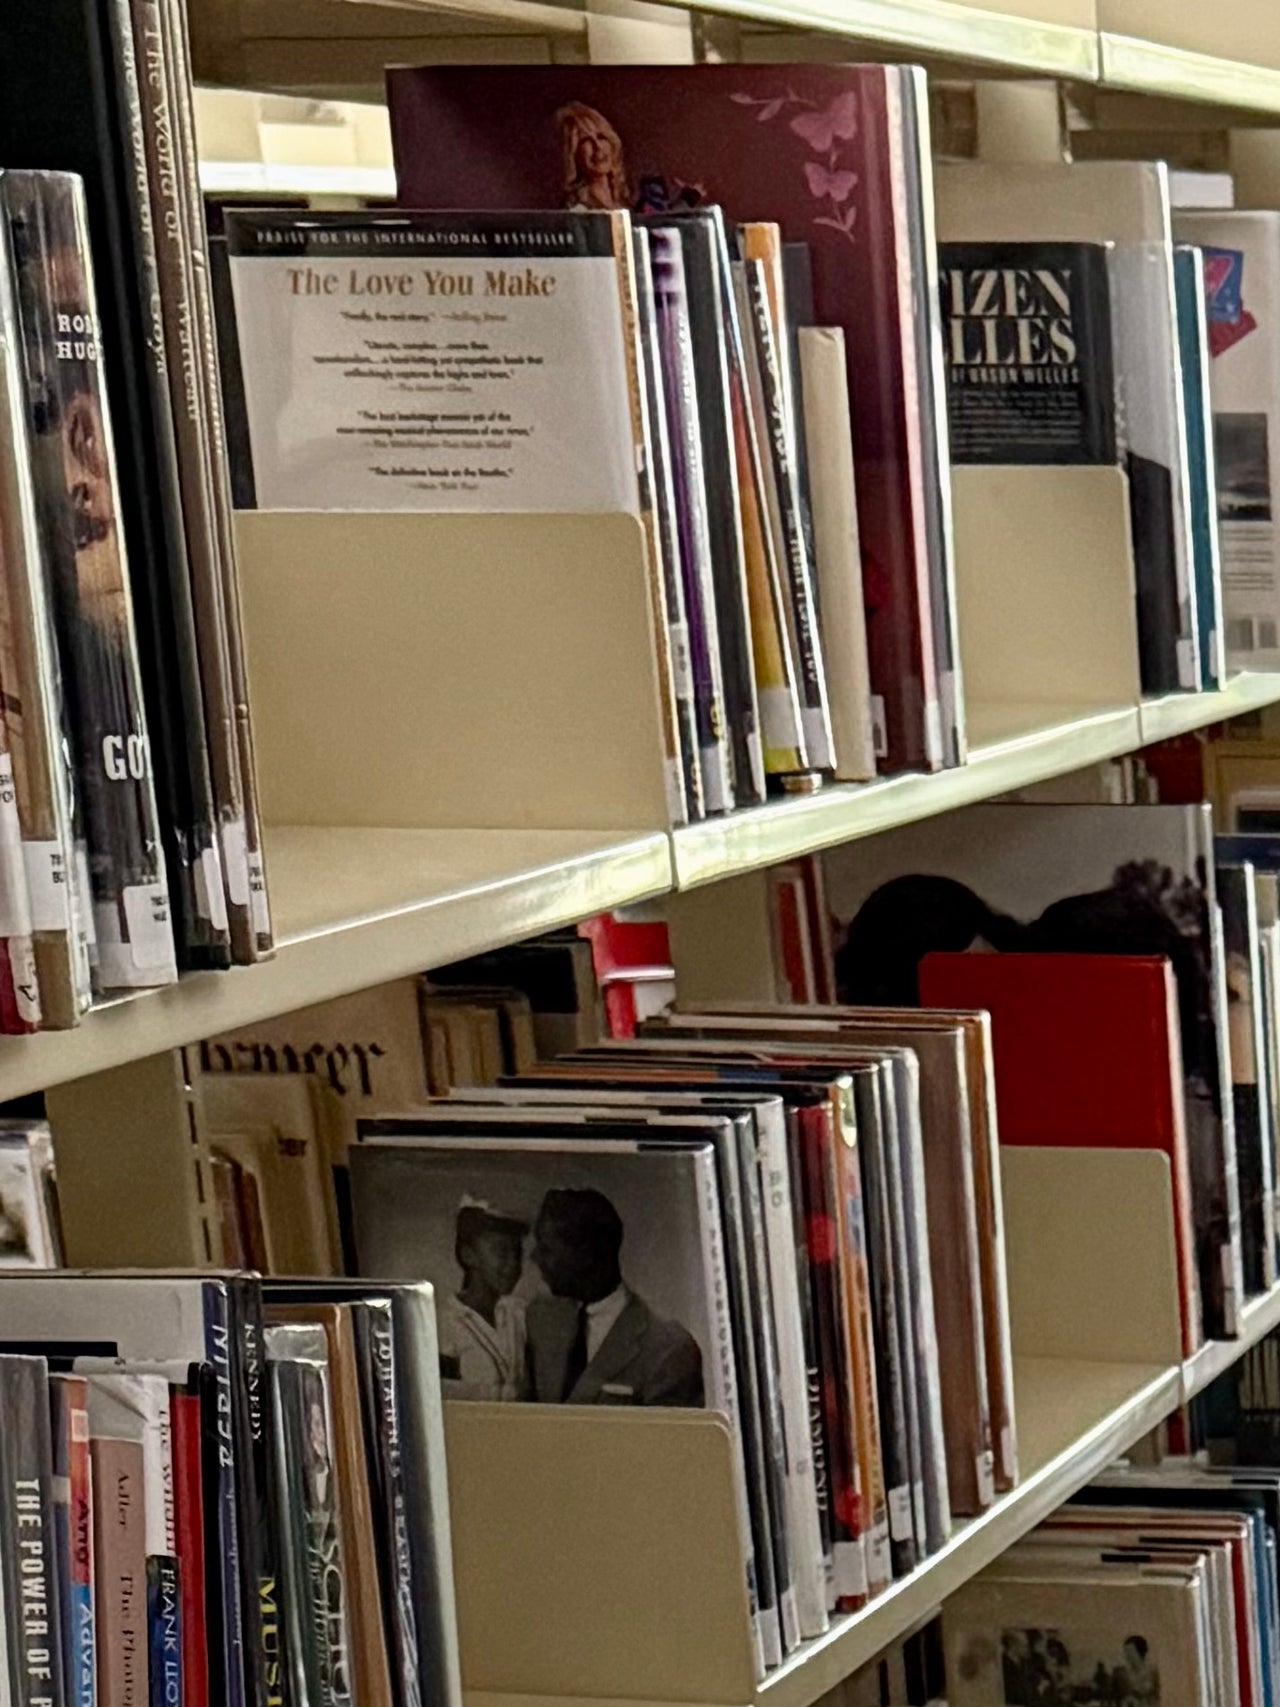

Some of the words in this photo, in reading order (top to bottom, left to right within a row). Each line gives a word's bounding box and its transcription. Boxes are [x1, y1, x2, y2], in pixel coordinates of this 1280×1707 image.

[287, 268, 340, 296] The
[348, 268, 414, 297] Love
[424, 269, 474, 297] You
[482, 268, 557, 297] Make
[940, 268, 1072, 317] IZEN
[14, 1478, 41, 1528] THE
[116, 1470, 130, 1531] Adler
[71, 1499, 91, 1568] Ang
[18, 1537, 50, 1637] POWER
[159, 1567, 179, 1652] FRANK
[26, 1648, 52, 1680] OF
